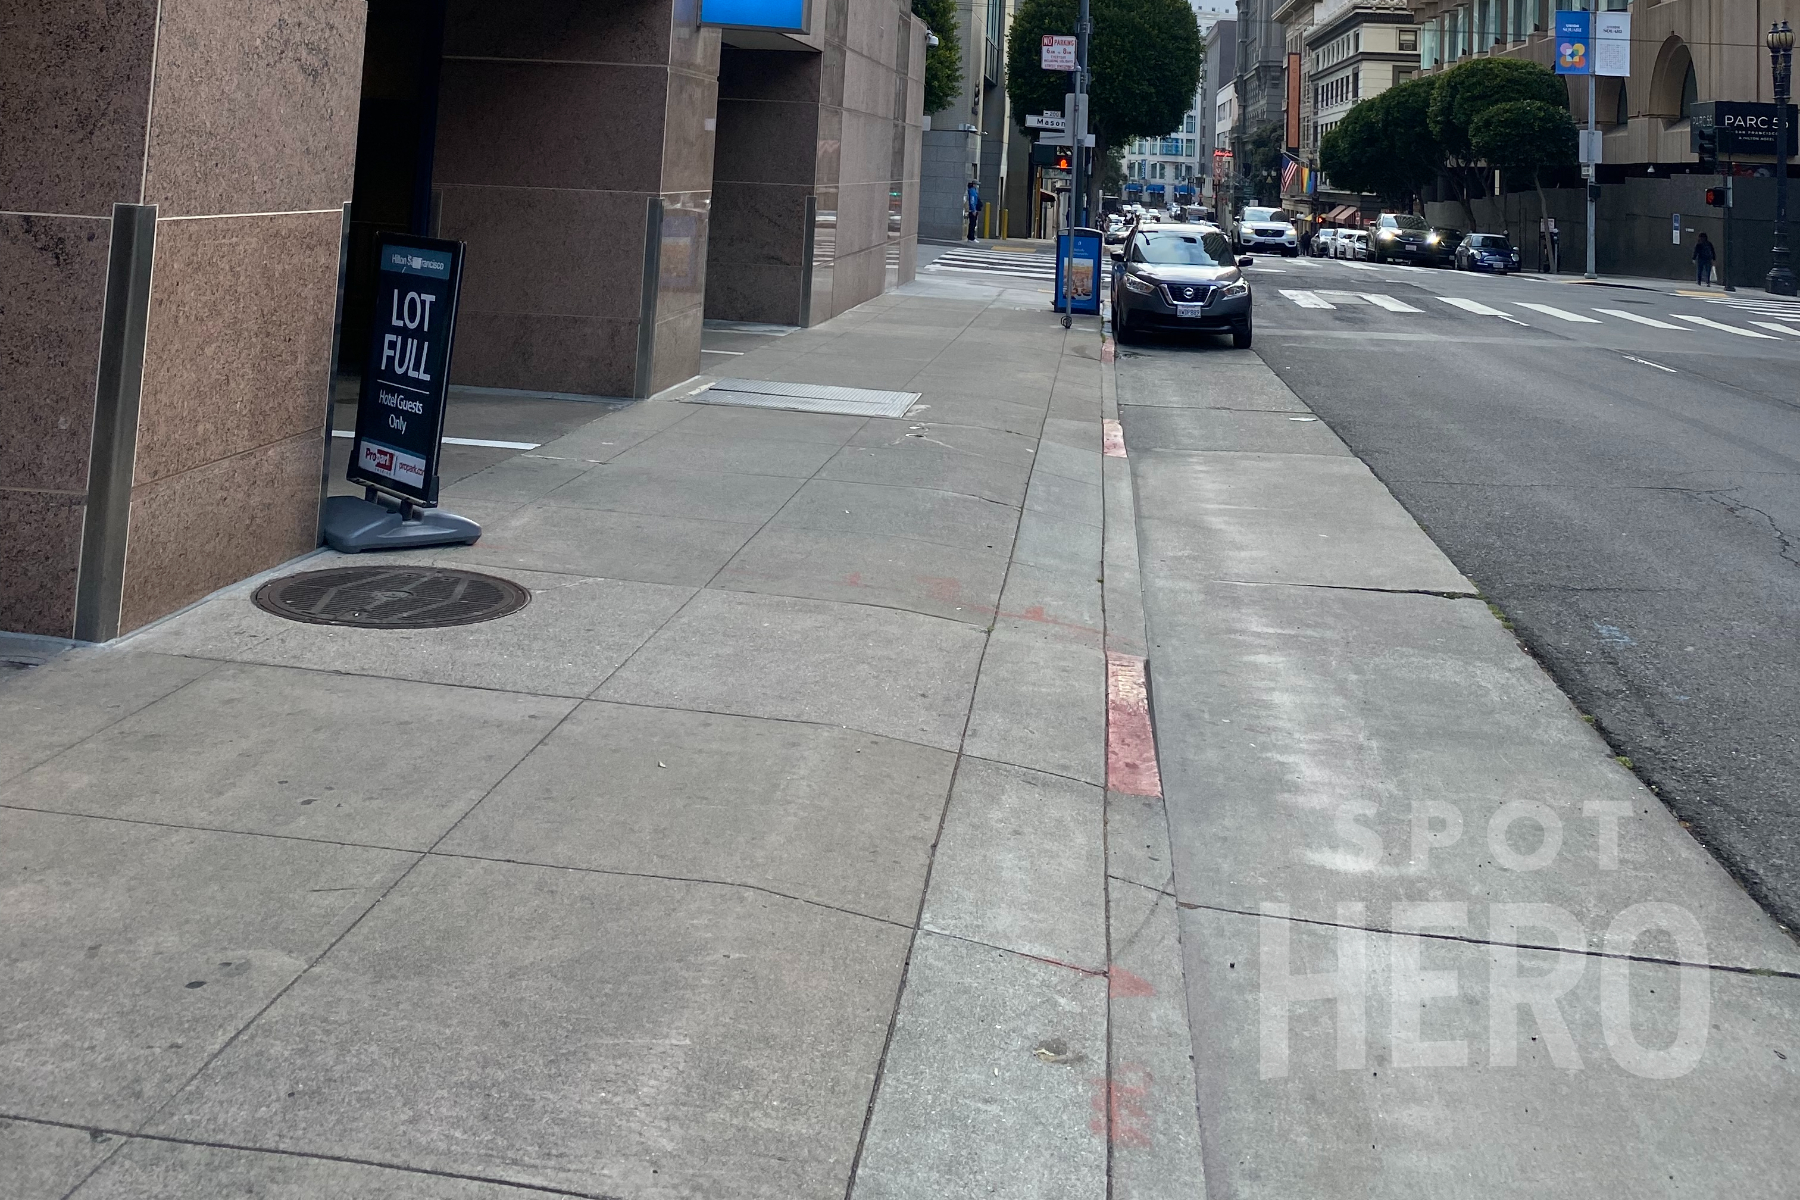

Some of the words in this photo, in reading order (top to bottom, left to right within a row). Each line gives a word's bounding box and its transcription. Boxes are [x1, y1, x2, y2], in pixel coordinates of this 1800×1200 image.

[1043, 36, 1053, 46] NO
[1054, 39, 1075, 47] PARKING
[1036, 118, 1066, 127] Mason
[1724, 115, 1768, 129] PARC
[391, 288, 436, 332] LOT
[381, 333, 431, 381] FULL
[379, 389, 398, 409] Hotel
[397, 395, 423, 415] Guests
[388, 413, 407, 435] Only
